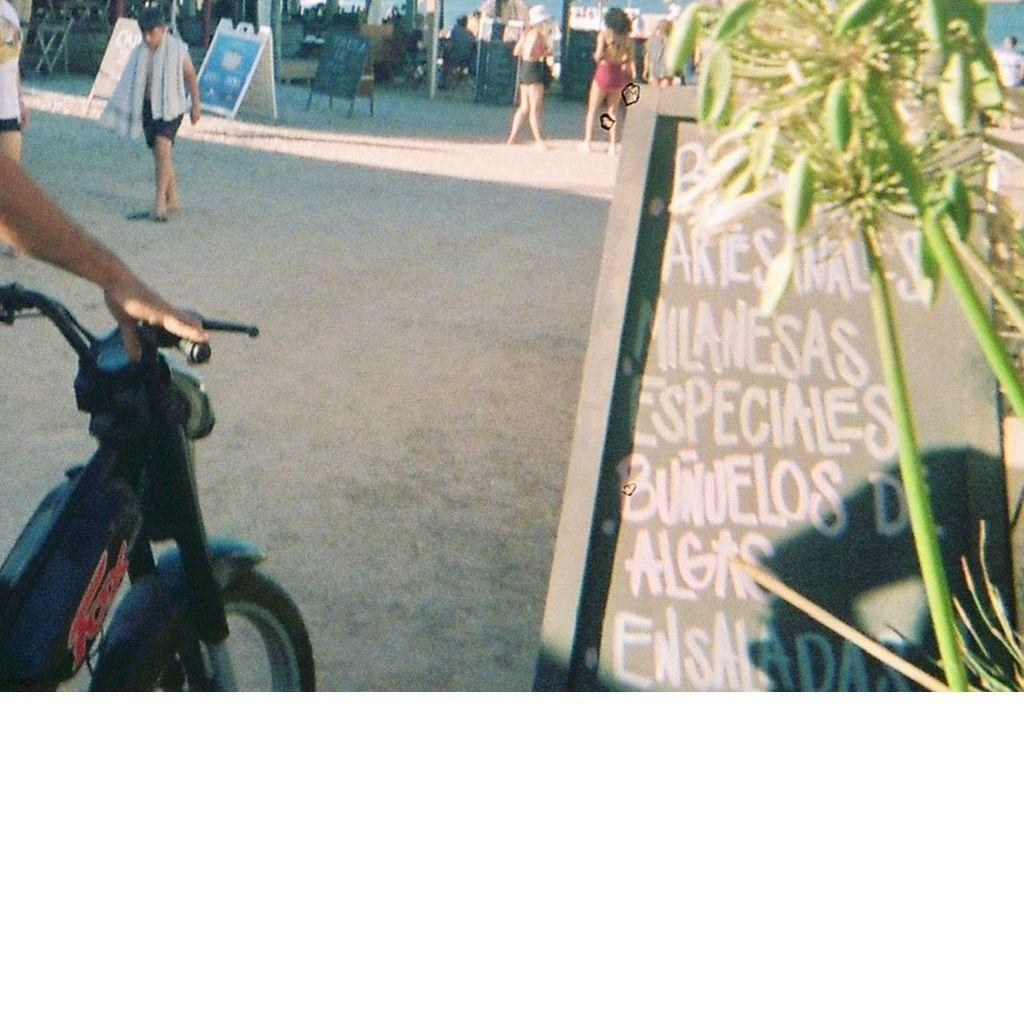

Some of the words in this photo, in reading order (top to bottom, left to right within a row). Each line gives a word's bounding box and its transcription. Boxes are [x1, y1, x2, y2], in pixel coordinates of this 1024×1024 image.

[665, 222, 932, 304] ARTESNALS
[632, 374, 900, 462] ESPECIALES
[625, 449, 847, 538] BUÑUELOS
[625, 528, 775, 602] ALGAS
